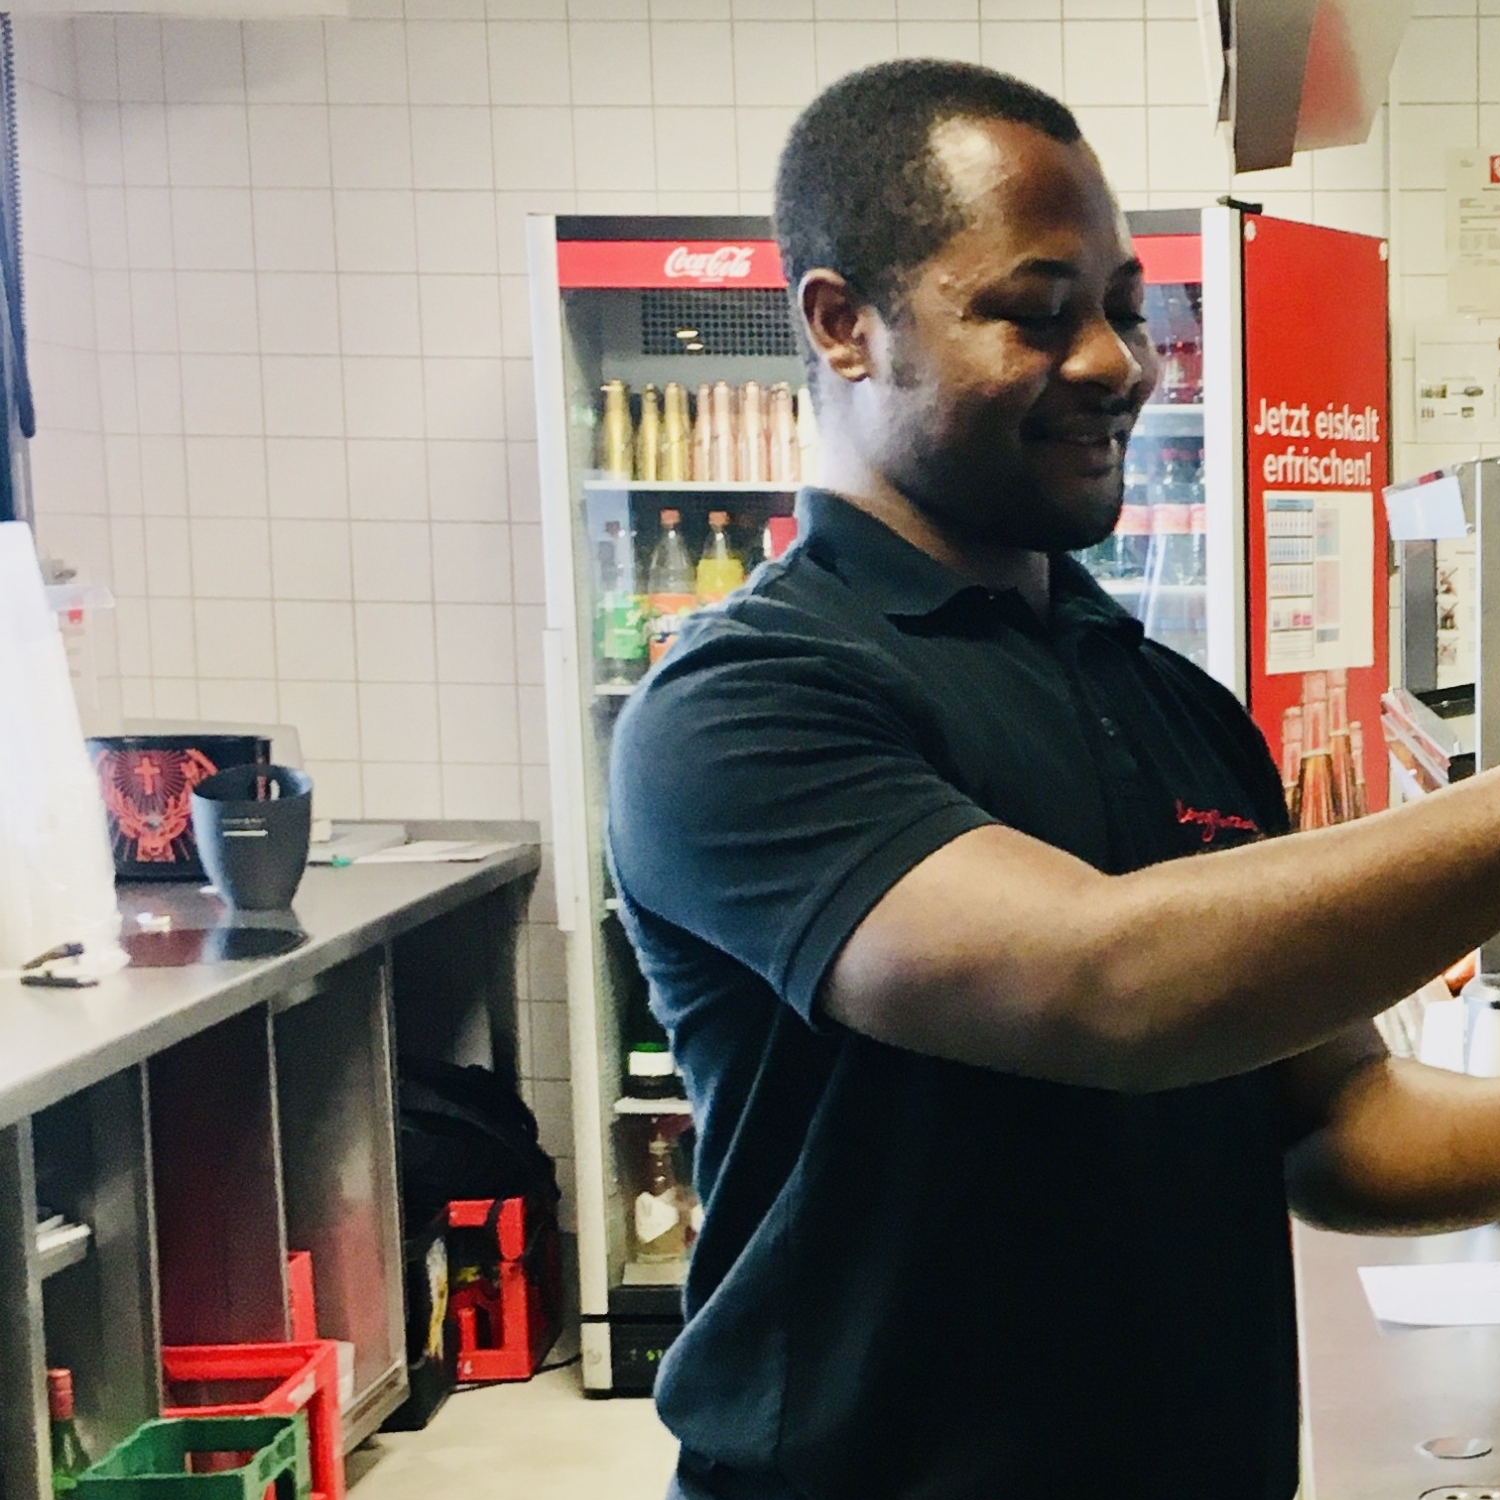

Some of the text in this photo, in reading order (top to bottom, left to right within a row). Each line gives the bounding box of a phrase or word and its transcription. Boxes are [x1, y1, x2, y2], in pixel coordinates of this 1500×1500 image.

[1254, 397, 1380, 442] Jetzt eiskalt
[1263, 445, 1371, 486] erfrischen!
